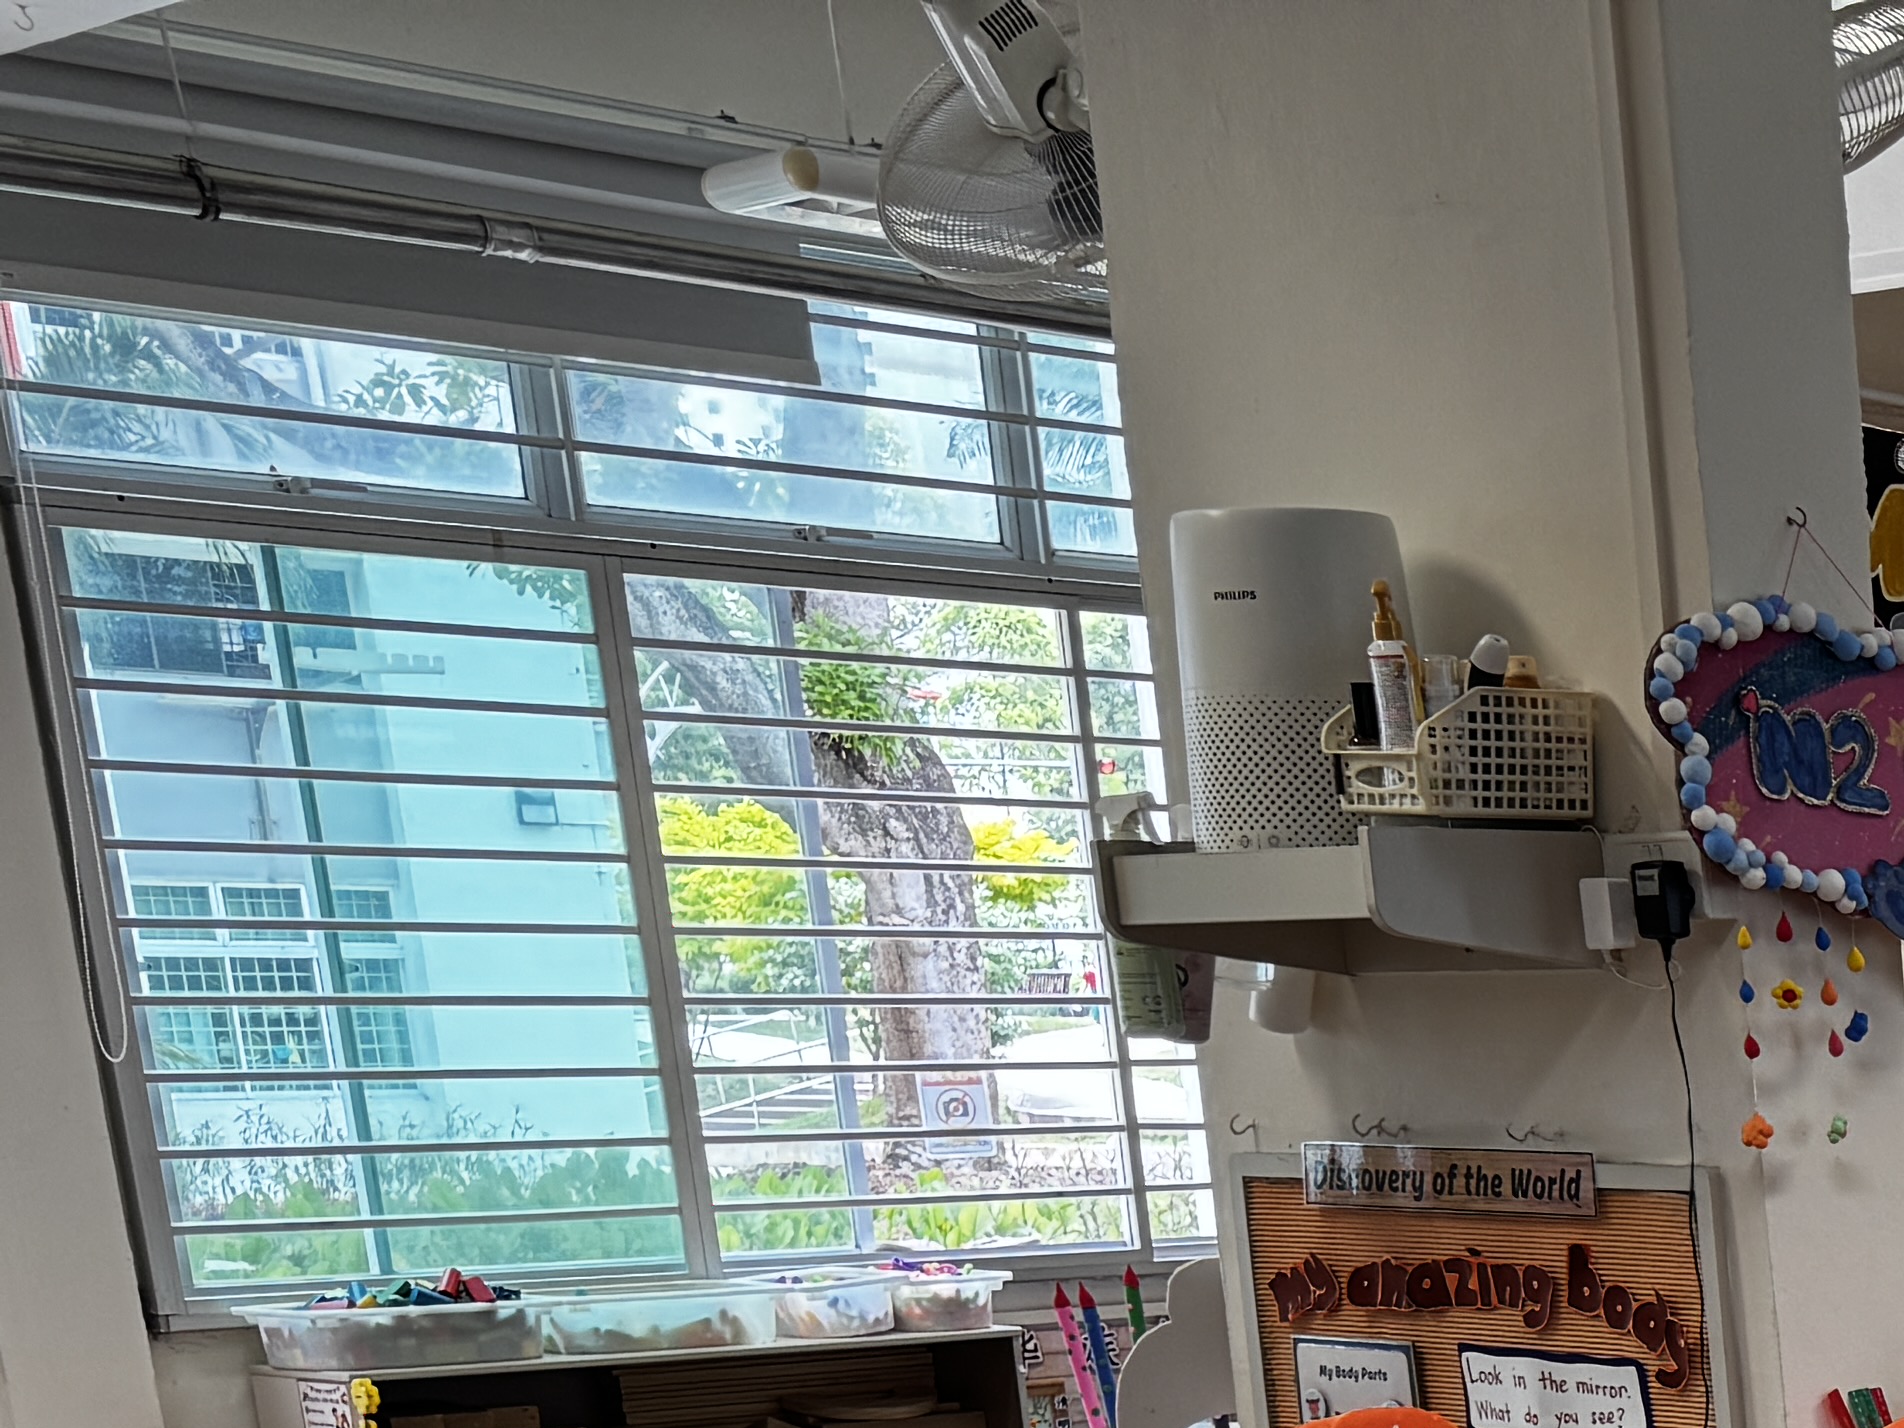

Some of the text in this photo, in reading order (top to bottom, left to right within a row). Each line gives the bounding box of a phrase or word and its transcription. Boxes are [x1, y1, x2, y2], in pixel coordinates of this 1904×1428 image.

[1213, 590, 1257, 601] PHILIPS
[1432, 1162, 1457, 1197] of
[1464, 1164, 1503, 1198] the
[1510, 1166, 1583, 1208] World
[1346, 1248, 1553, 1332] amazing
[1566, 1243, 1690, 1391] body
[1319, 1364, 1389, 1383] My Body Parts
[1466, 1356, 1632, 1400] Look in the mirror.
[1474, 1400, 1511, 1424] What
[1524, 1404, 1539, 1427] do
